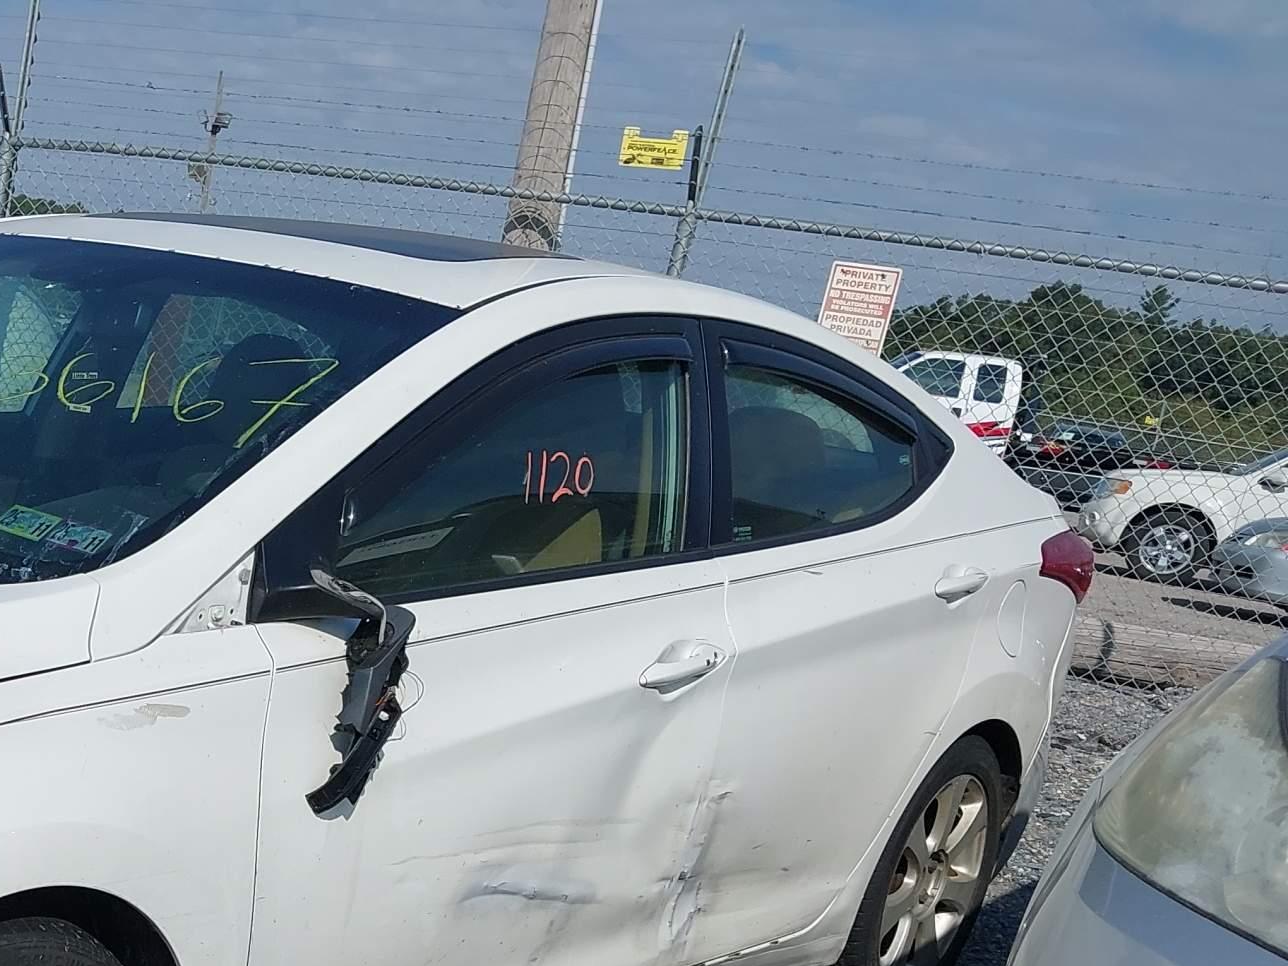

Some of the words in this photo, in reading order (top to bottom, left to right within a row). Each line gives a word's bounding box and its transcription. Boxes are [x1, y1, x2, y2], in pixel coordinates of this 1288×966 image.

[844, 269, 887, 281] PRIVATE
[835, 278, 892, 292] PROPERTY
[829, 289, 841, 298] NO
[841, 290, 892, 304] TRESPASSING
[868, 303, 884, 311] WILL
[824, 313, 882, 328] PROPIEDAD
[830, 323, 873, 337] PRIVADA
[522, 450, 595, 504] 1120
